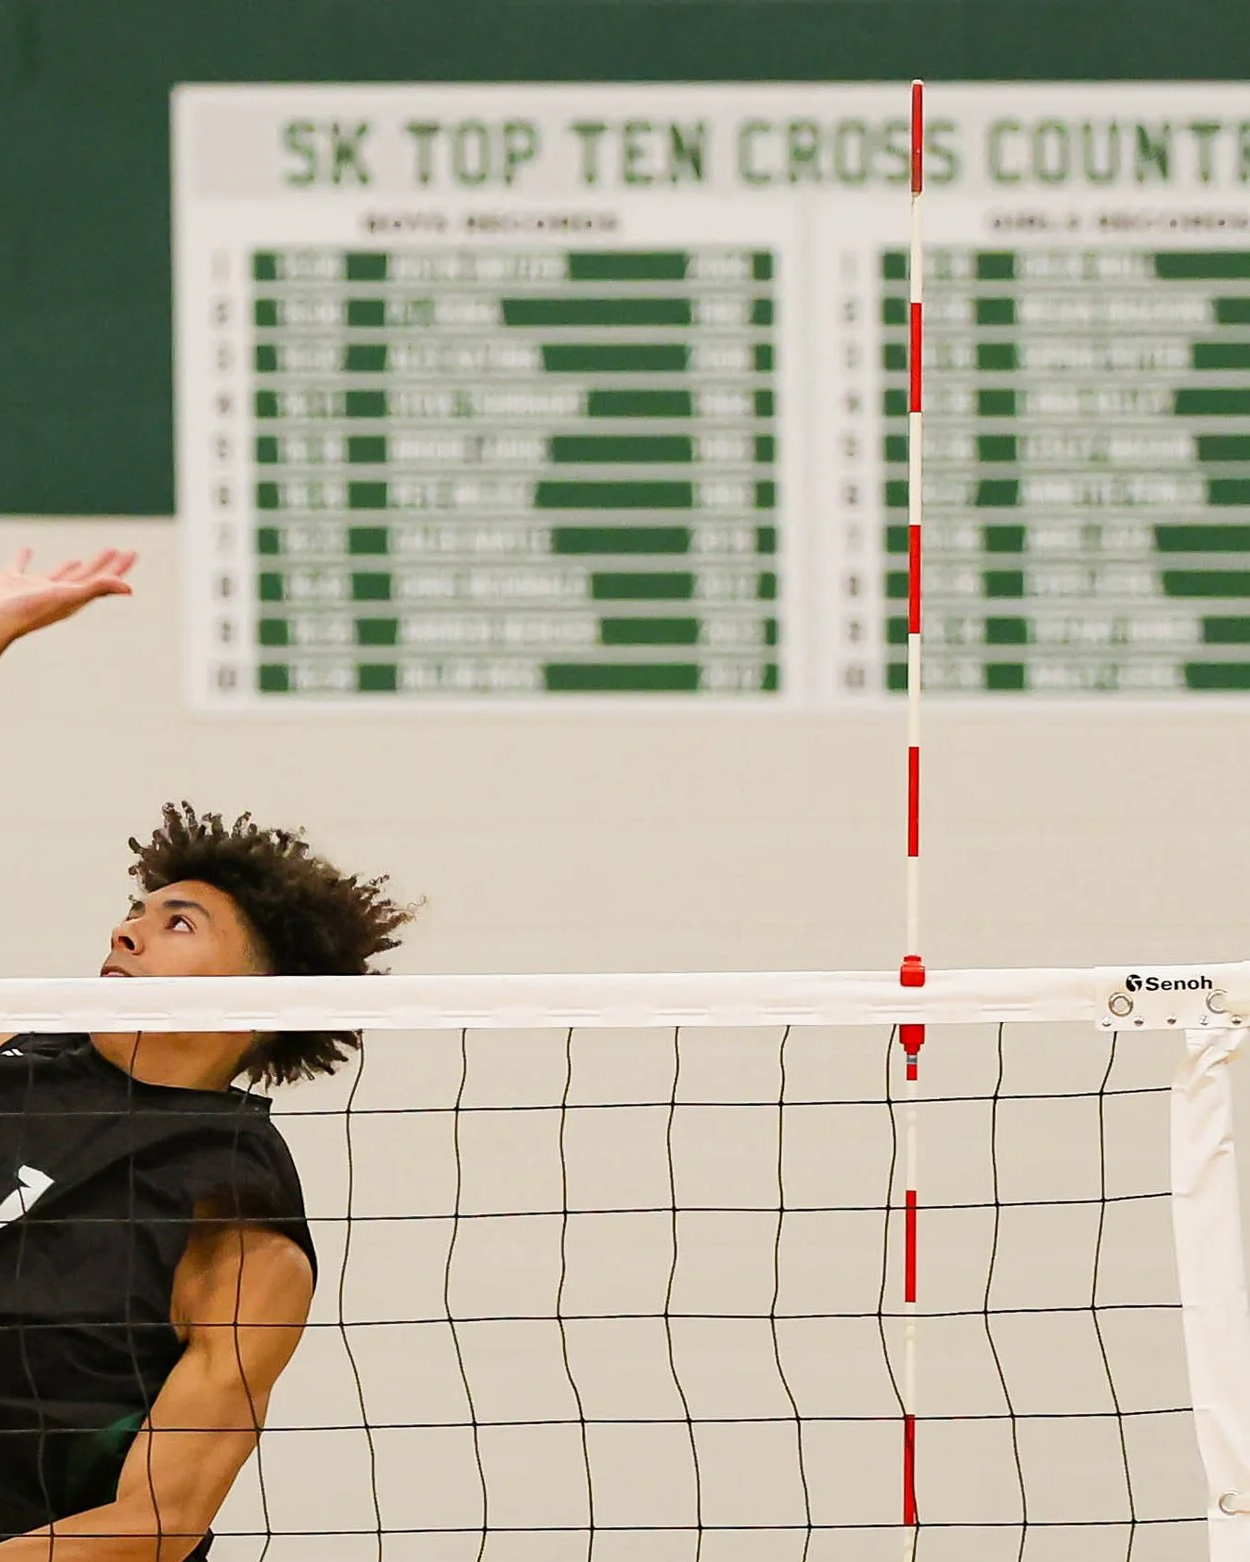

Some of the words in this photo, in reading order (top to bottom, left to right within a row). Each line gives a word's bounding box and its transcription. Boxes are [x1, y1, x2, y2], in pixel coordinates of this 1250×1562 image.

[283, 121, 370, 185] SK
[405, 121, 538, 185] TOP
[570, 120, 706, 185] TEN
[738, 120, 961, 185] CROSS
[1145, 975, 1213, 992] Senoh
